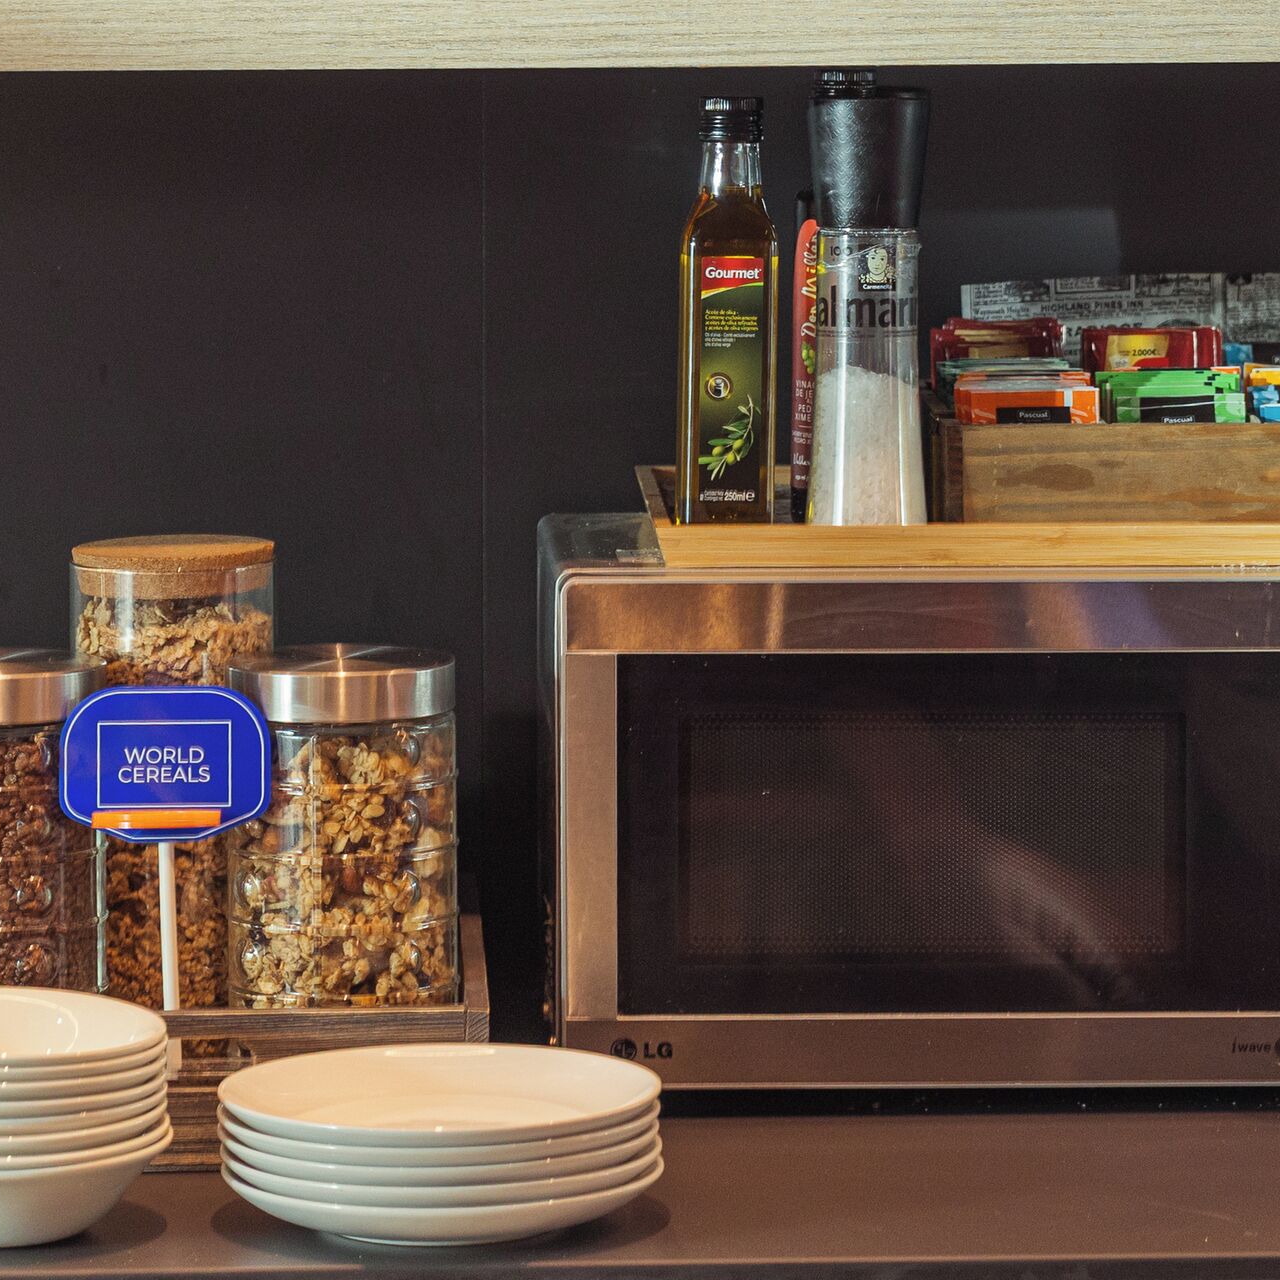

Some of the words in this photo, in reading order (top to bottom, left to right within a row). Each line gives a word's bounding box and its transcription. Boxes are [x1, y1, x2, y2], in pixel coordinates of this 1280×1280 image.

[705, 266, 760, 280] Gourmet
[1040, 303, 1090, 312] HIGHLAND
[1094, 302, 1122, 310] PINES
[1127, 300, 1144, 308] INN
[1019, 411, 1048, 419] Pascual
[1164, 416, 1193, 424] Pascual
[724, 492, 746, 502] 250ml
[124, 746, 204, 764] WORLD
[118, 766, 211, 784] CEREALS
[644, 1042, 673, 1058] LG
